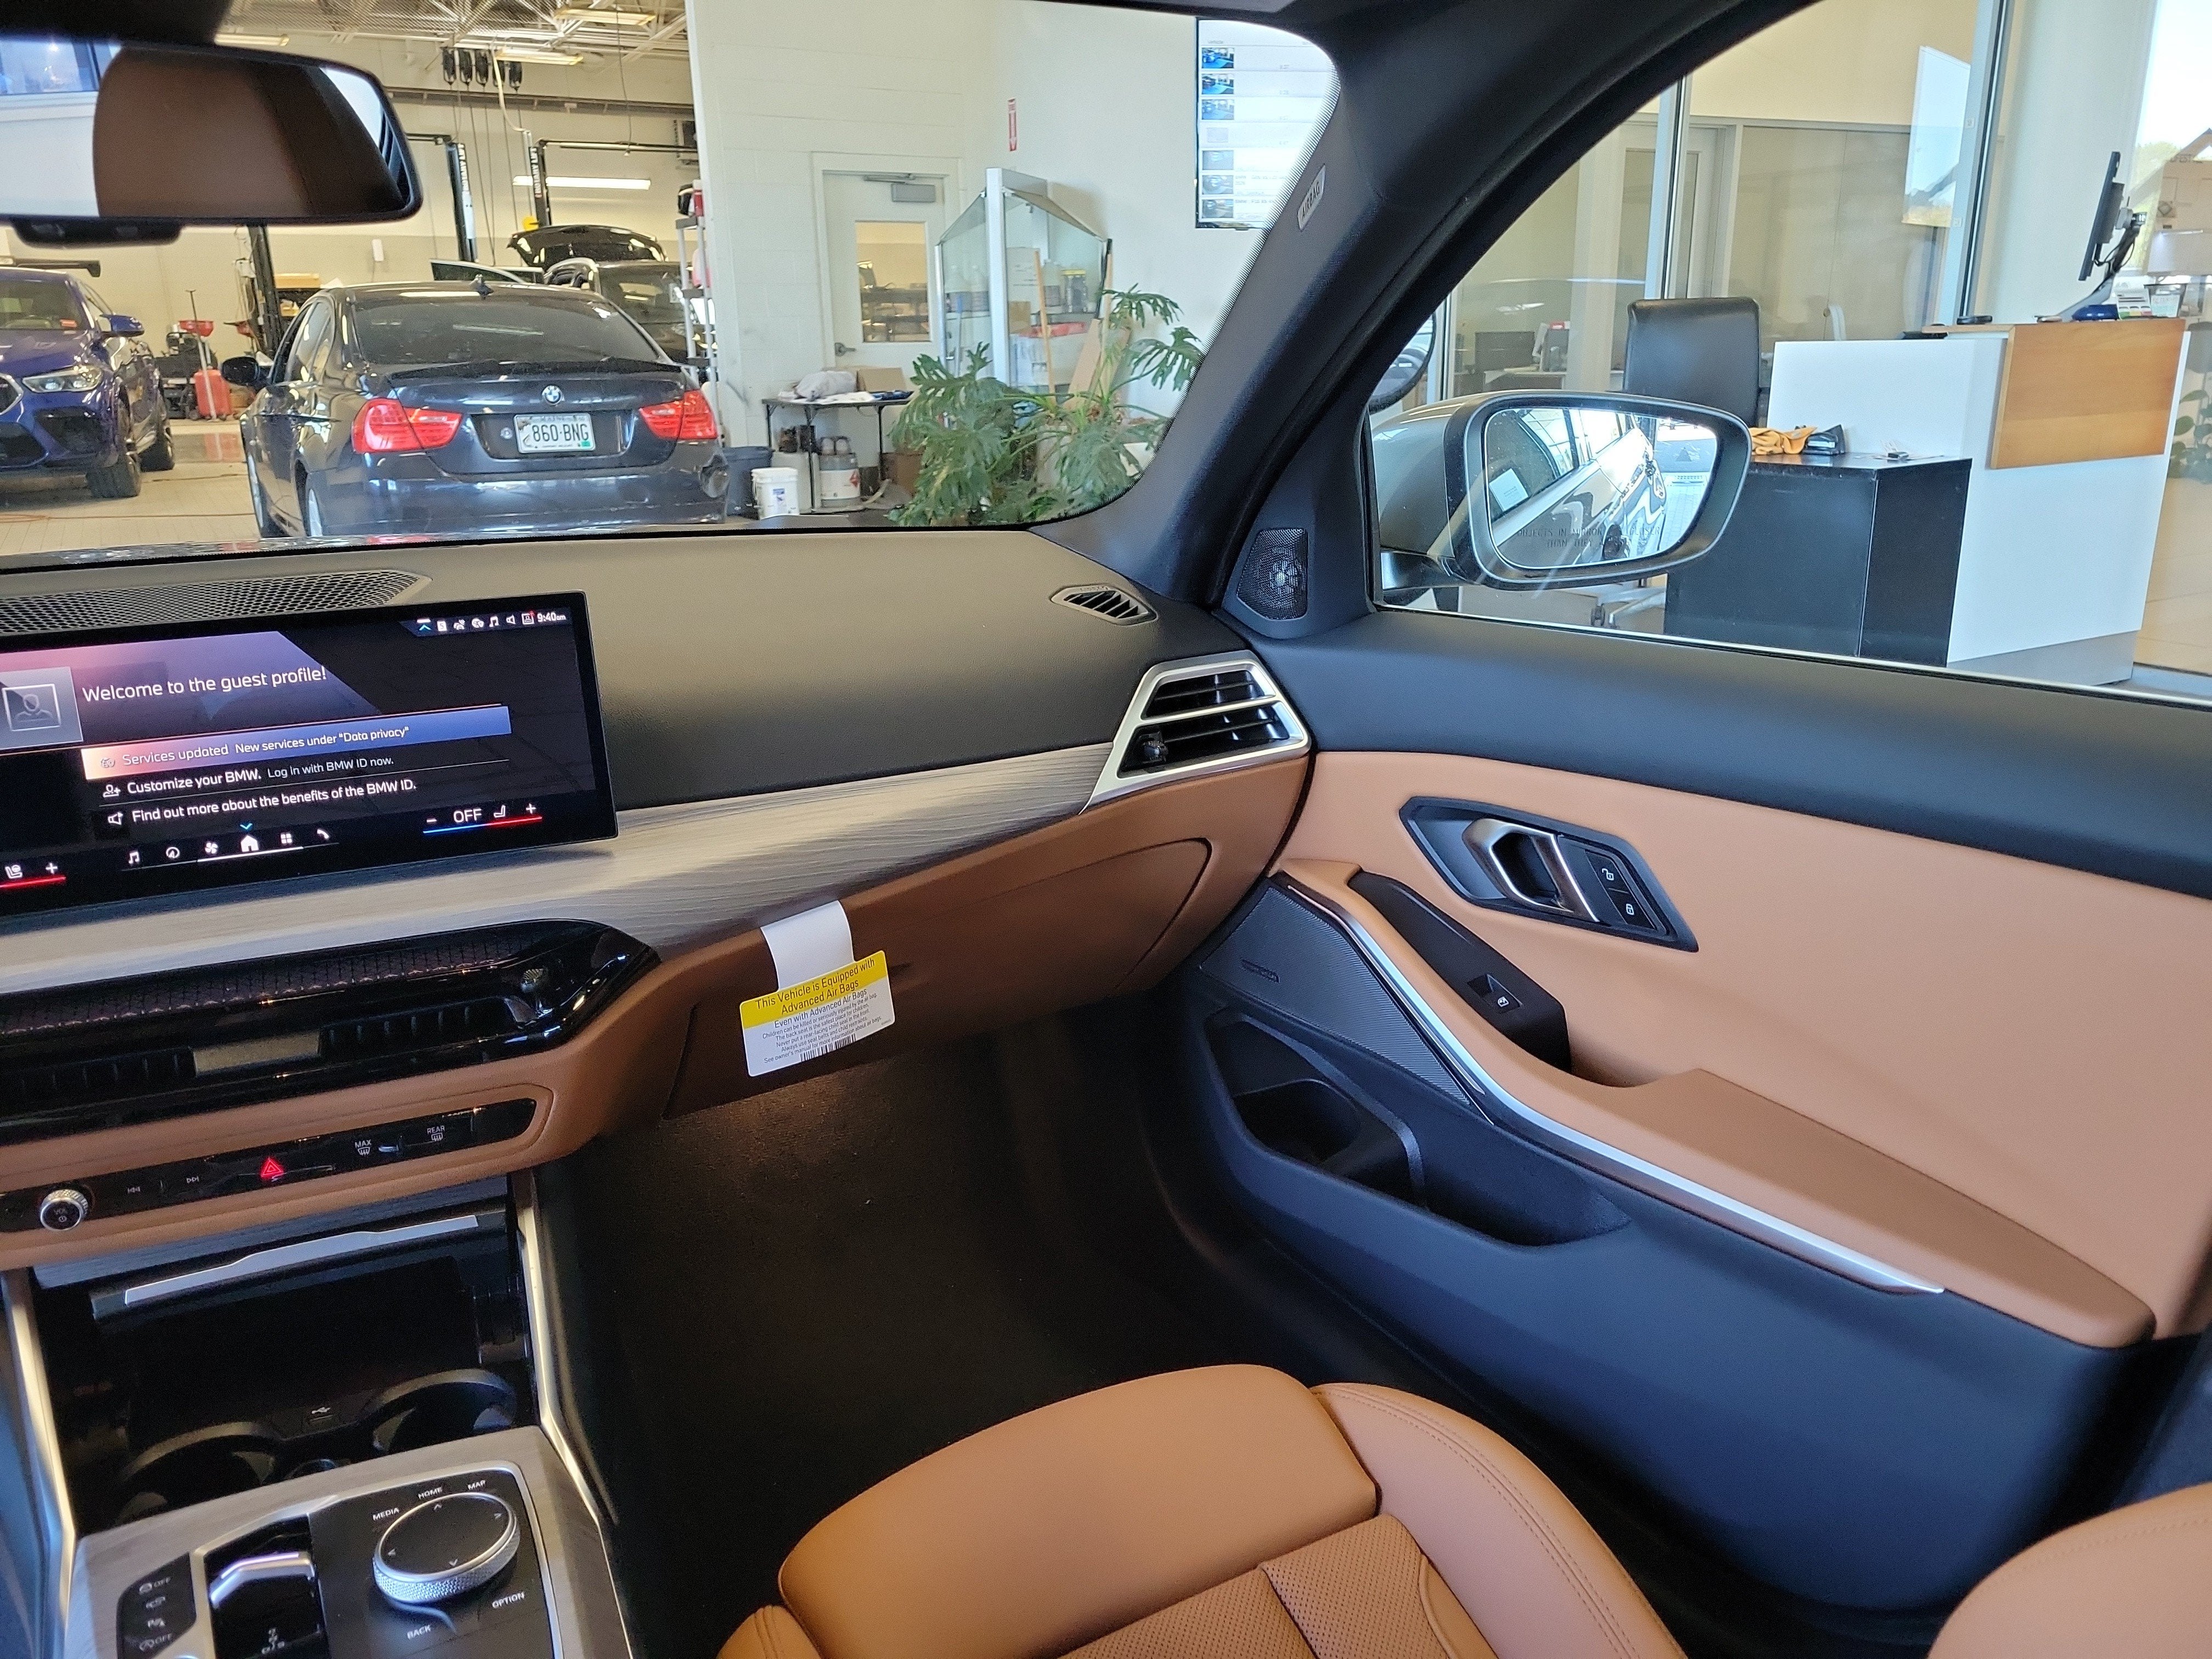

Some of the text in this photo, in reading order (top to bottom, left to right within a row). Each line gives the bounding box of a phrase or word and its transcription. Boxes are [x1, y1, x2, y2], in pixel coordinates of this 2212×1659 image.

[1302, 181, 1320, 220] AIRBAG
[1517, 528, 1553, 538] OBJECTS
[1559, 528, 1566, 537] IN
[1547, 539, 1567, 548] THAN
[82, 665, 326, 702] Welcome to the guest profile!
[122, 726, 409, 765] Services updated New services under "Data privacy"
[127, 757, 394, 794] Customize your BMW. Log in with BMW ID now.
[132, 779, 416, 822] Find out more about the benefits of the BMW ID.
[453, 808, 482, 823] OFF
[755, 957, 875, 1009] This Vehicle is Equipped with
[782, 979, 859, 1014] Advanced Air Bags
[774, 989, 867, 1028] Even with Advanced Air Bags
[763, 1029, 783, 1039] Children
[800, 1019, 812, 1028] killed
[818, 1011, 837, 1020] seriously
[838, 1004, 851, 1014] injured
[821, 1018, 834, 1026] safest
[803, 1026, 828, 1039] rear-facing
[775, 1051, 793, 1060] owner's
[794, 1045, 811, 1054] manual
[831, 1029, 855, 1041] information
[855, 1023, 866, 1032] about
[781, 1043, 798, 1052] Always
[427, 1125, 445, 1135] REAR
[354, 1139, 372, 1148] MAX
[418, 1487, 443, 1499] HOME
[467, 1480, 486, 1491] MAP
[372, 1507, 400, 1521] MEDIA
[492, 1592, 525, 1609] OPTION
[407, 1624, 431, 1640] BACK
